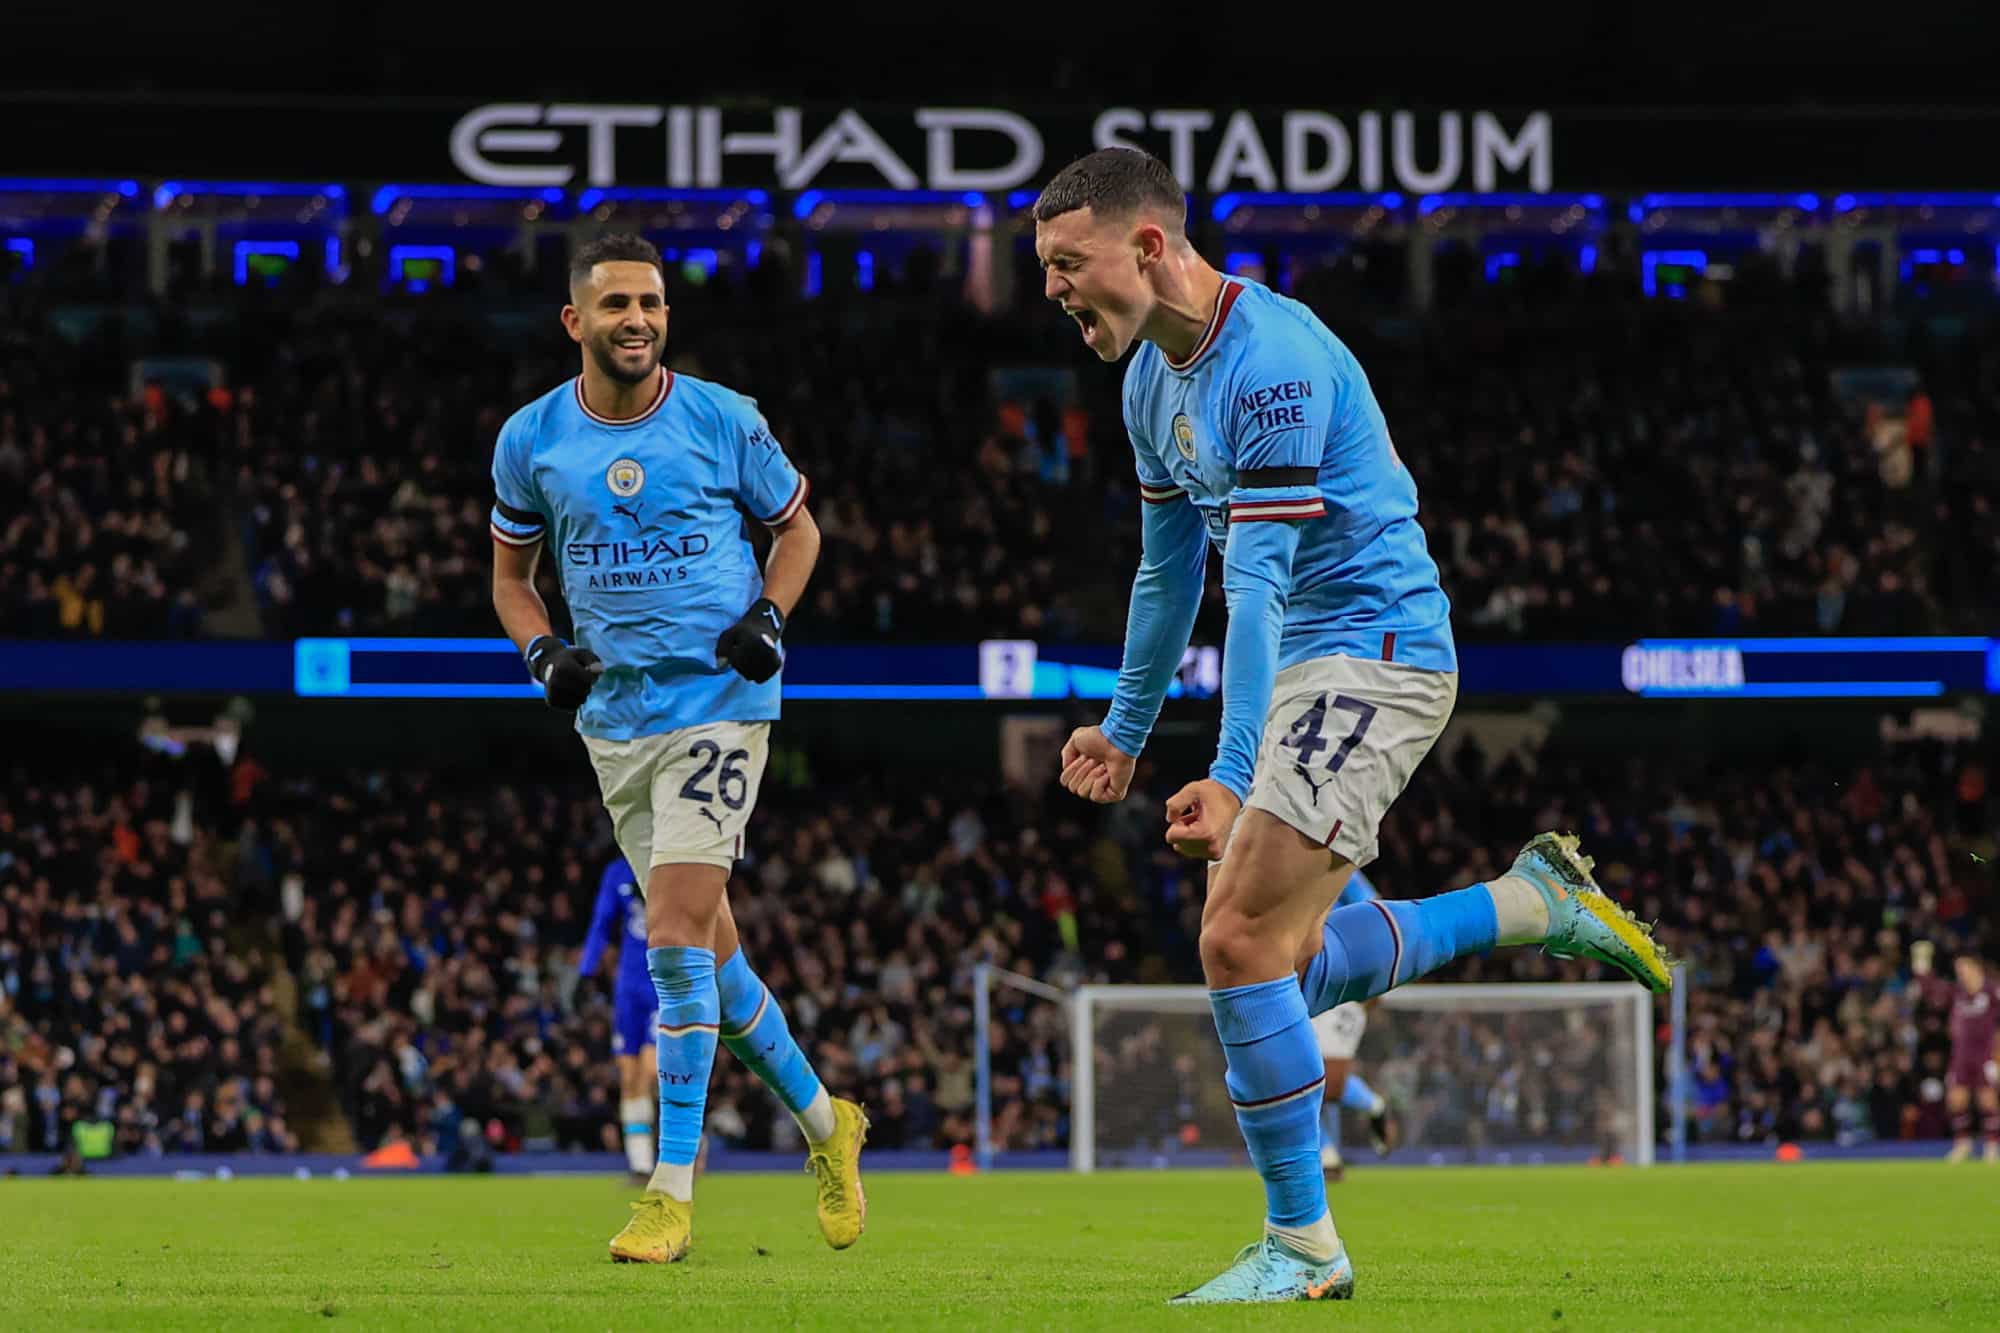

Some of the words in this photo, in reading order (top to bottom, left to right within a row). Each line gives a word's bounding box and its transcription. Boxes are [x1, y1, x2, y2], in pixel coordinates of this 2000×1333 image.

[449, 104, 1044, 190] ETIHAD
[1241, 380, 1312, 415] NEXEN
[1252, 405, 1305, 430] TIRE
[567, 534, 709, 566] ETIHAD
[588, 566, 688, 588] AIRWAYS
[1279, 692, 1378, 773] 47
[679, 739, 749, 810] 26
